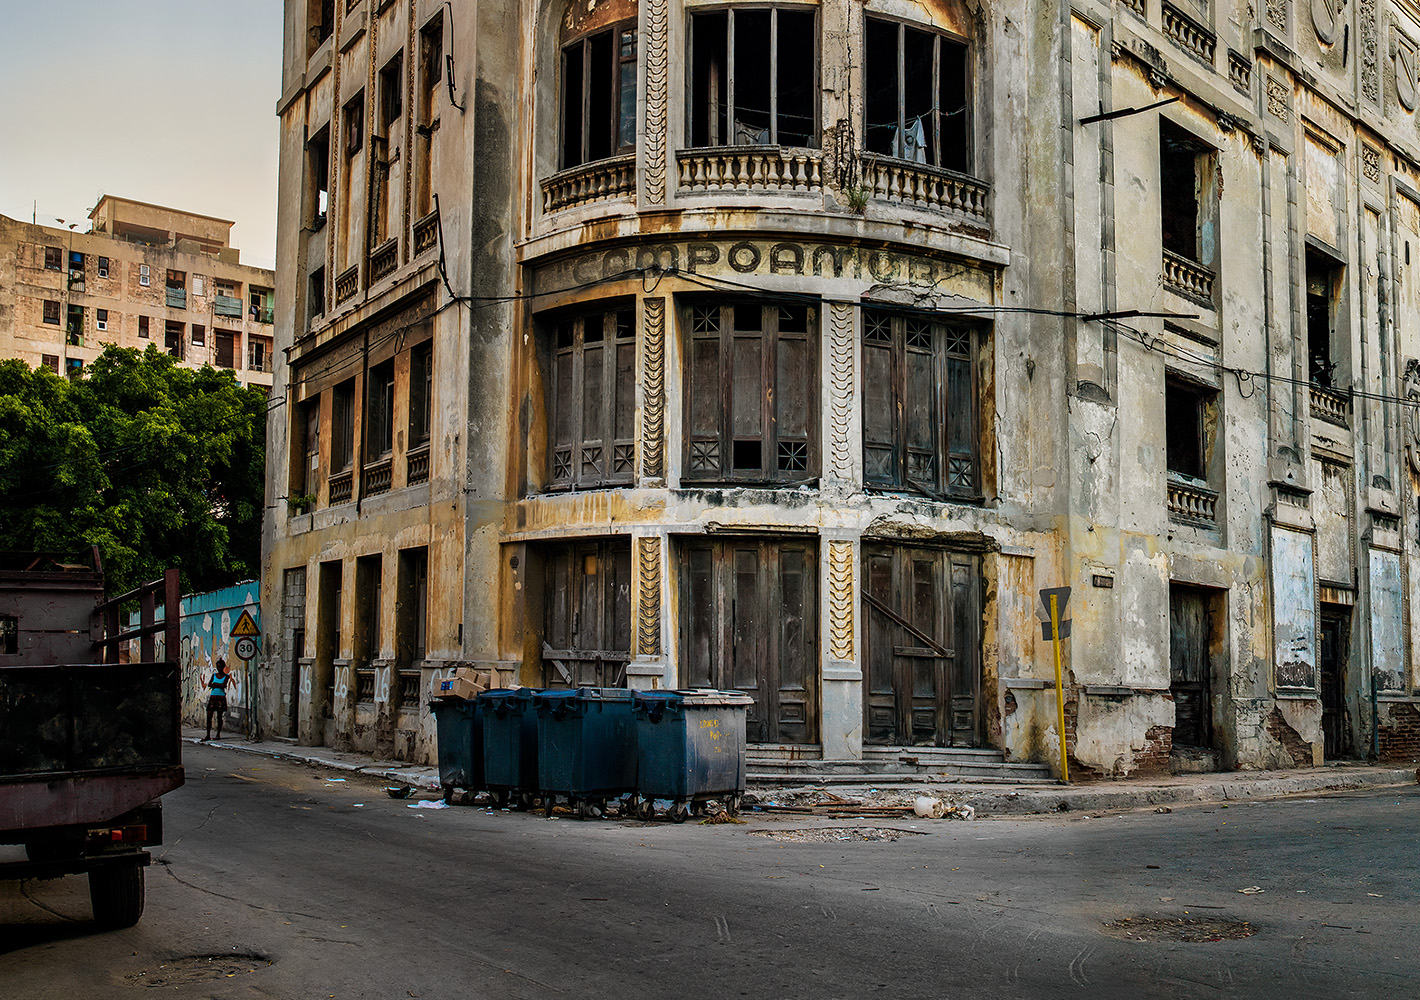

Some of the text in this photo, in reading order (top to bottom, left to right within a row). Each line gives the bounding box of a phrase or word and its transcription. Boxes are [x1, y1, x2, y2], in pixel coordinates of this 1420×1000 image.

[239, 644, 253, 653] 30
[299, 665, 312, 694] 26
[334, 666, 349, 699] 26
[374, 666, 391, 702] 26
